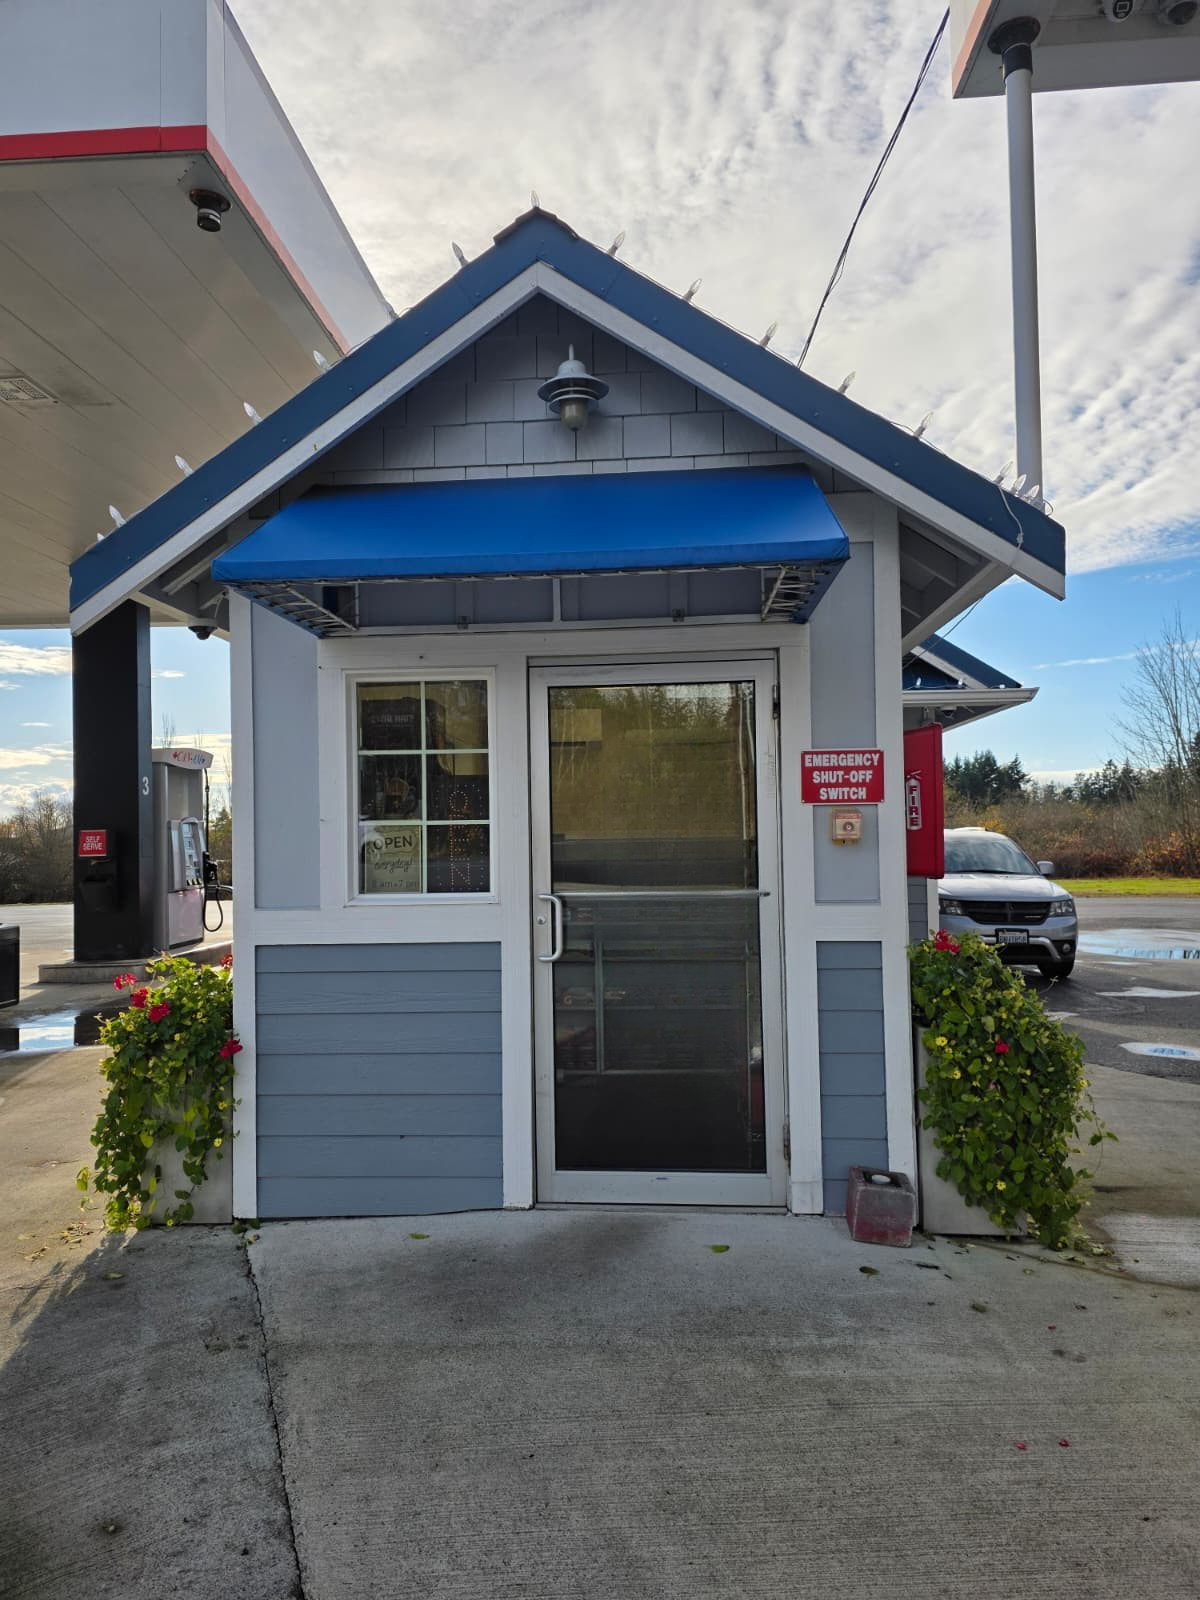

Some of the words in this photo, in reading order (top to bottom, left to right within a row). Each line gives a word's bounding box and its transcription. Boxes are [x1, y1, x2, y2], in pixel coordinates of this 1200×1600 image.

[804, 753, 880, 767] EMERGENCY
[812, 770, 873, 784] SHUT-OFF
[142, 776, 150, 796] 3
[819, 787, 867, 800] SWITCH
[910, 786, 919, 826] FIRE
[83, 842, 102, 850] SERVE
[373, 835, 412, 850] OPEN
